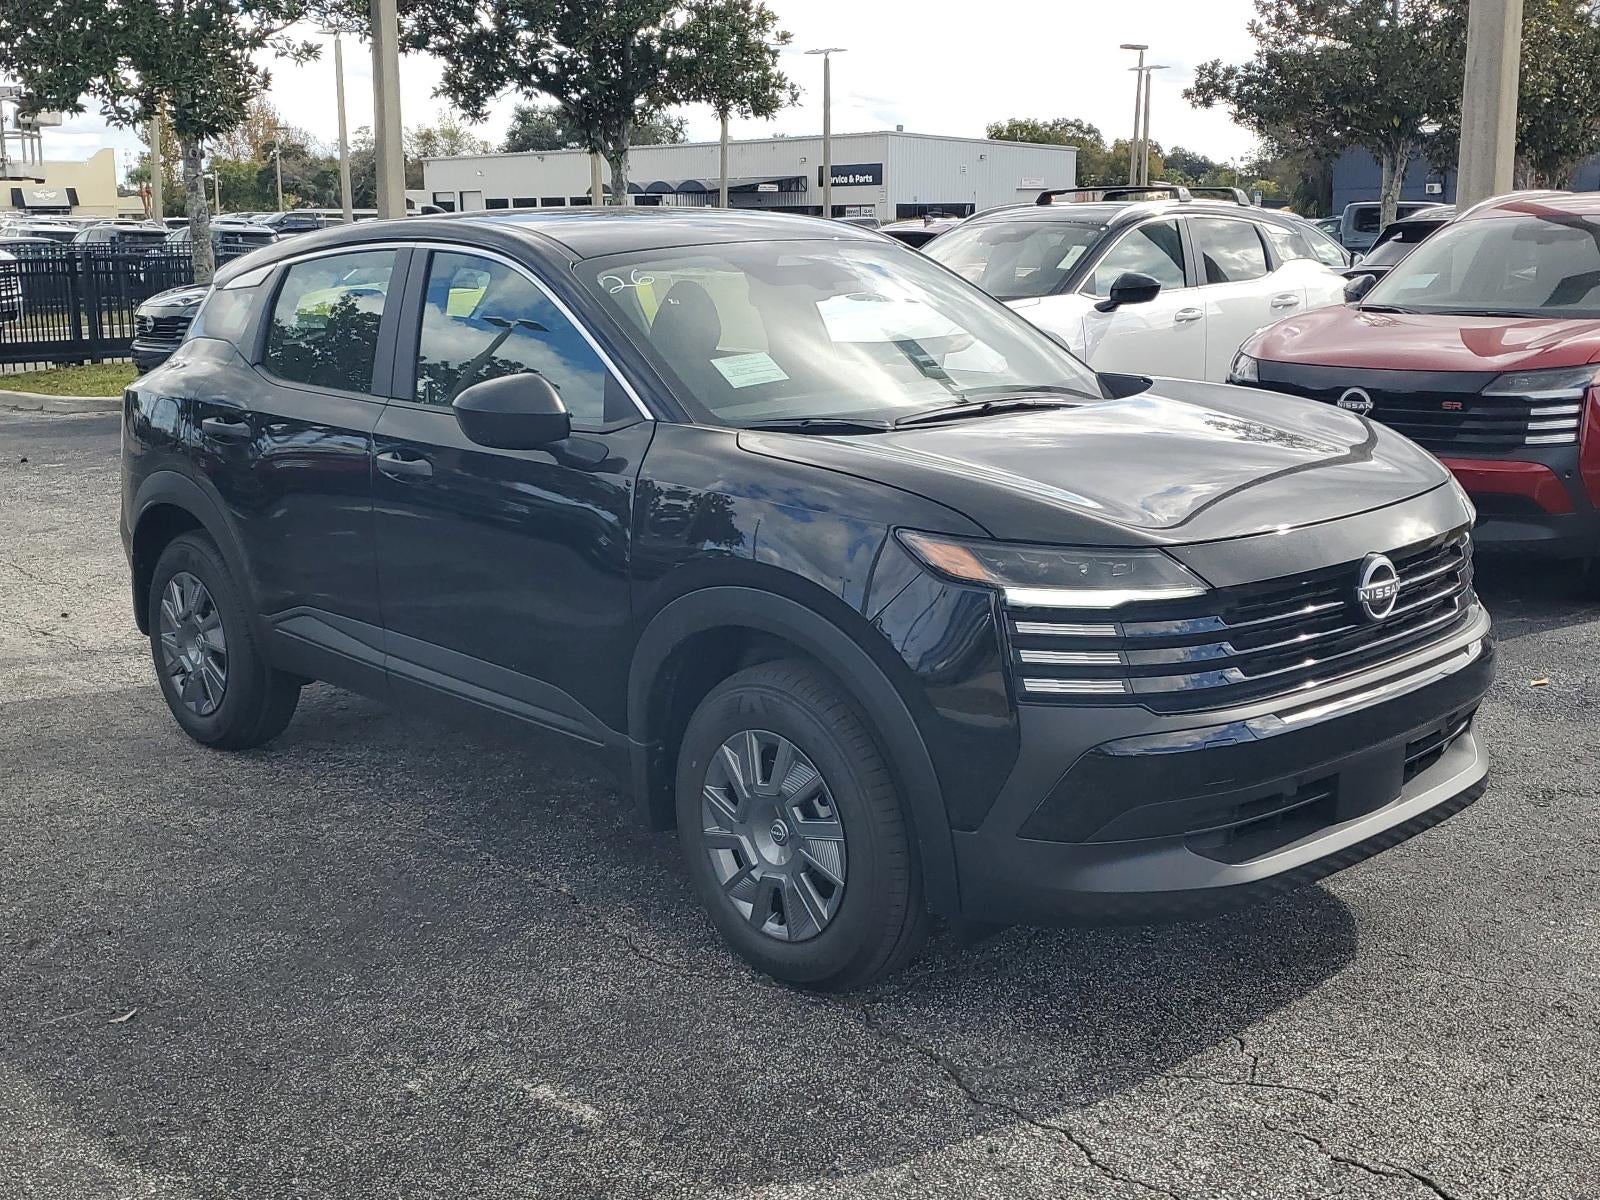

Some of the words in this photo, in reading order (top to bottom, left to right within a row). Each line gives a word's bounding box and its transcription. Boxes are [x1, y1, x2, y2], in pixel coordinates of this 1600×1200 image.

[831, 175, 848, 184] ervice
[849, 174, 855, 183] &
[855, 174, 873, 183] Parts
[602, 268, 655, 294] 26
[1337, 401, 1373, 409] NISSAN
[1441, 401, 1462, 410] SR
[1360, 581, 1400, 601] NISSAN
